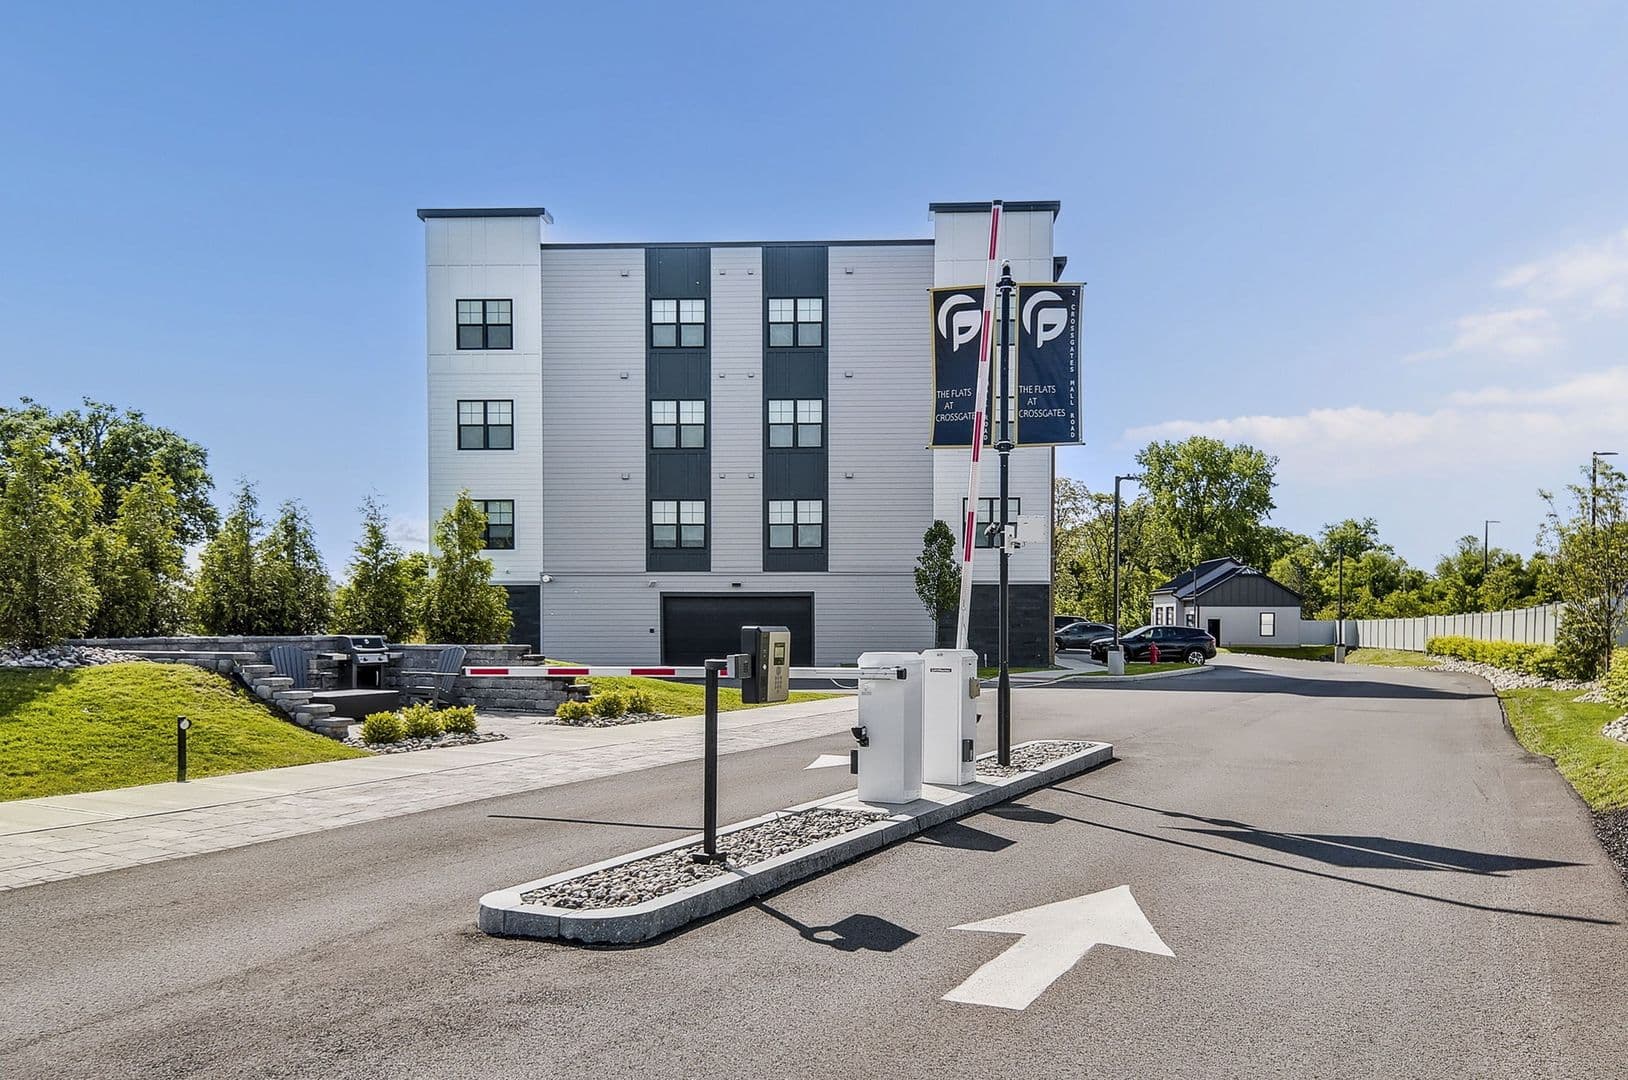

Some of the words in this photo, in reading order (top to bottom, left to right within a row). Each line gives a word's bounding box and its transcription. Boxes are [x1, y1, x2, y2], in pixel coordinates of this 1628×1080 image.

[936, 389, 950, 399] THE
[951, 388, 972, 398] FLATS
[1019, 385, 1033, 394] THE
[1034, 385, 1056, 394] FLATS
[944, 401, 954, 410] AT
[1027, 397, 1038, 406] AT
[935, 411, 976, 422] CROSSGATE
[1018, 408, 1066, 418] CROSSGATES
